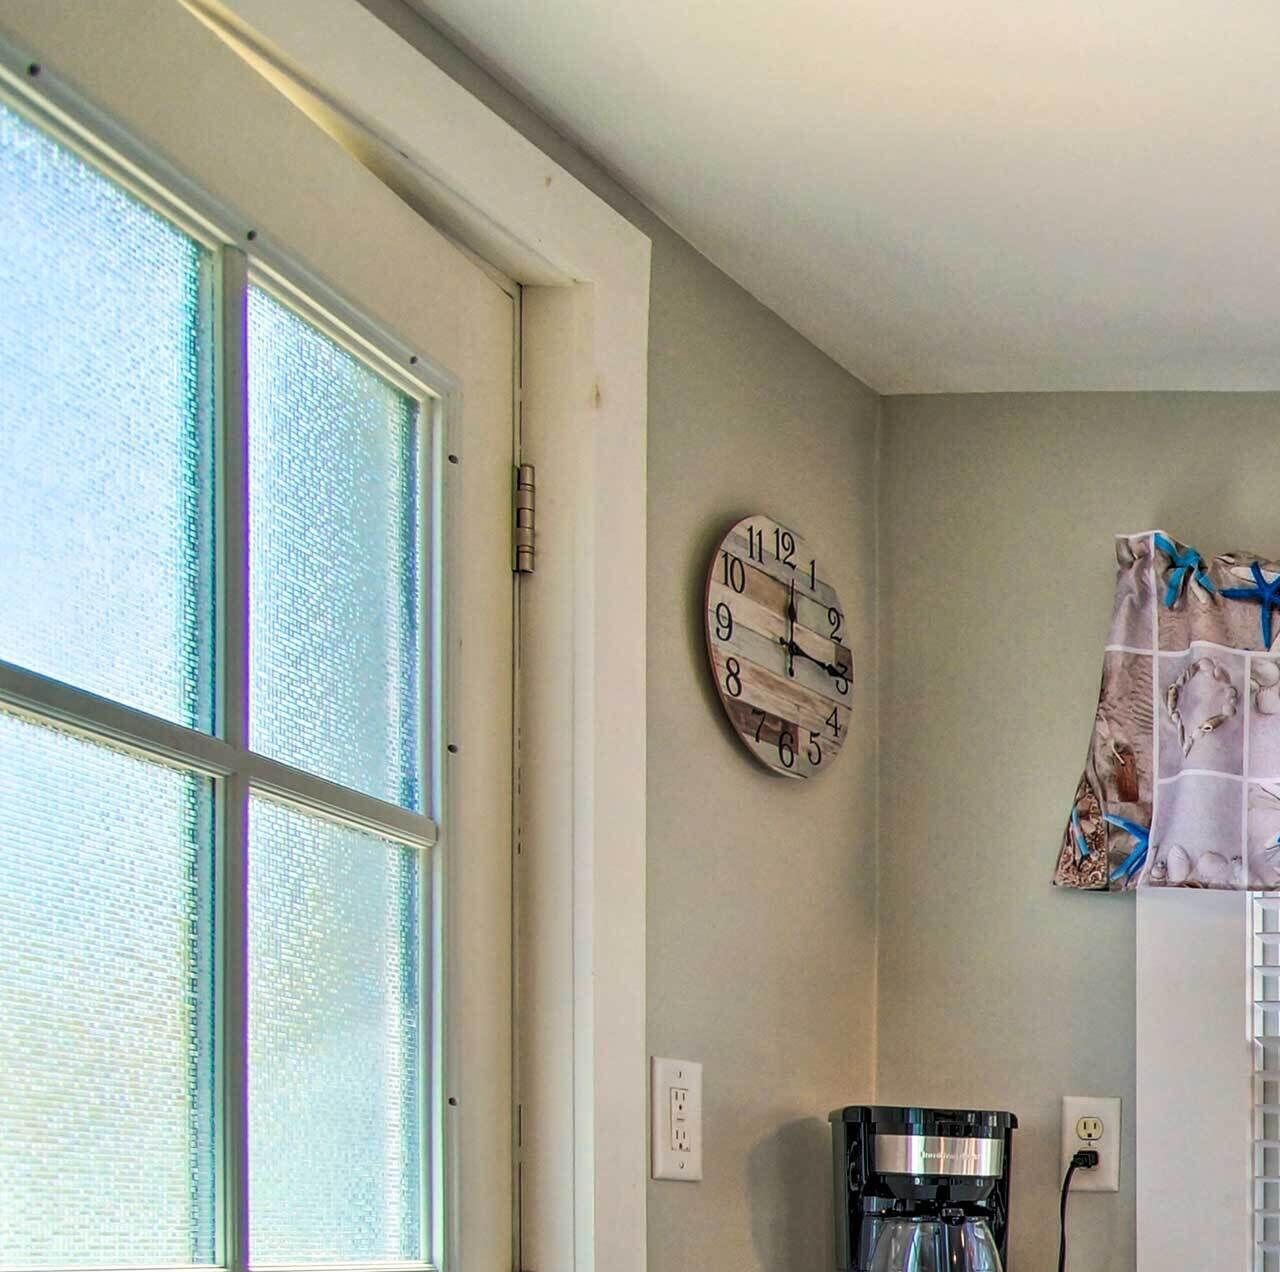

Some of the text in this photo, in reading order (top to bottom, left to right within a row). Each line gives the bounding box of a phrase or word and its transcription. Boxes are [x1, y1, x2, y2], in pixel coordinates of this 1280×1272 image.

[747, 525, 765, 564] 11
[773, 527, 797, 570] 12
[721, 551, 746, 594] 10
[809, 560, 817, 592] 1
[715, 602, 733, 641] 9
[827, 607, 842, 642] 2
[725, 657, 742, 697] 8
[752, 710, 767, 743] 7
[825, 707, 842, 737] 4
[779, 731, 794, 768] 6
[807, 732, 822, 766] 5
